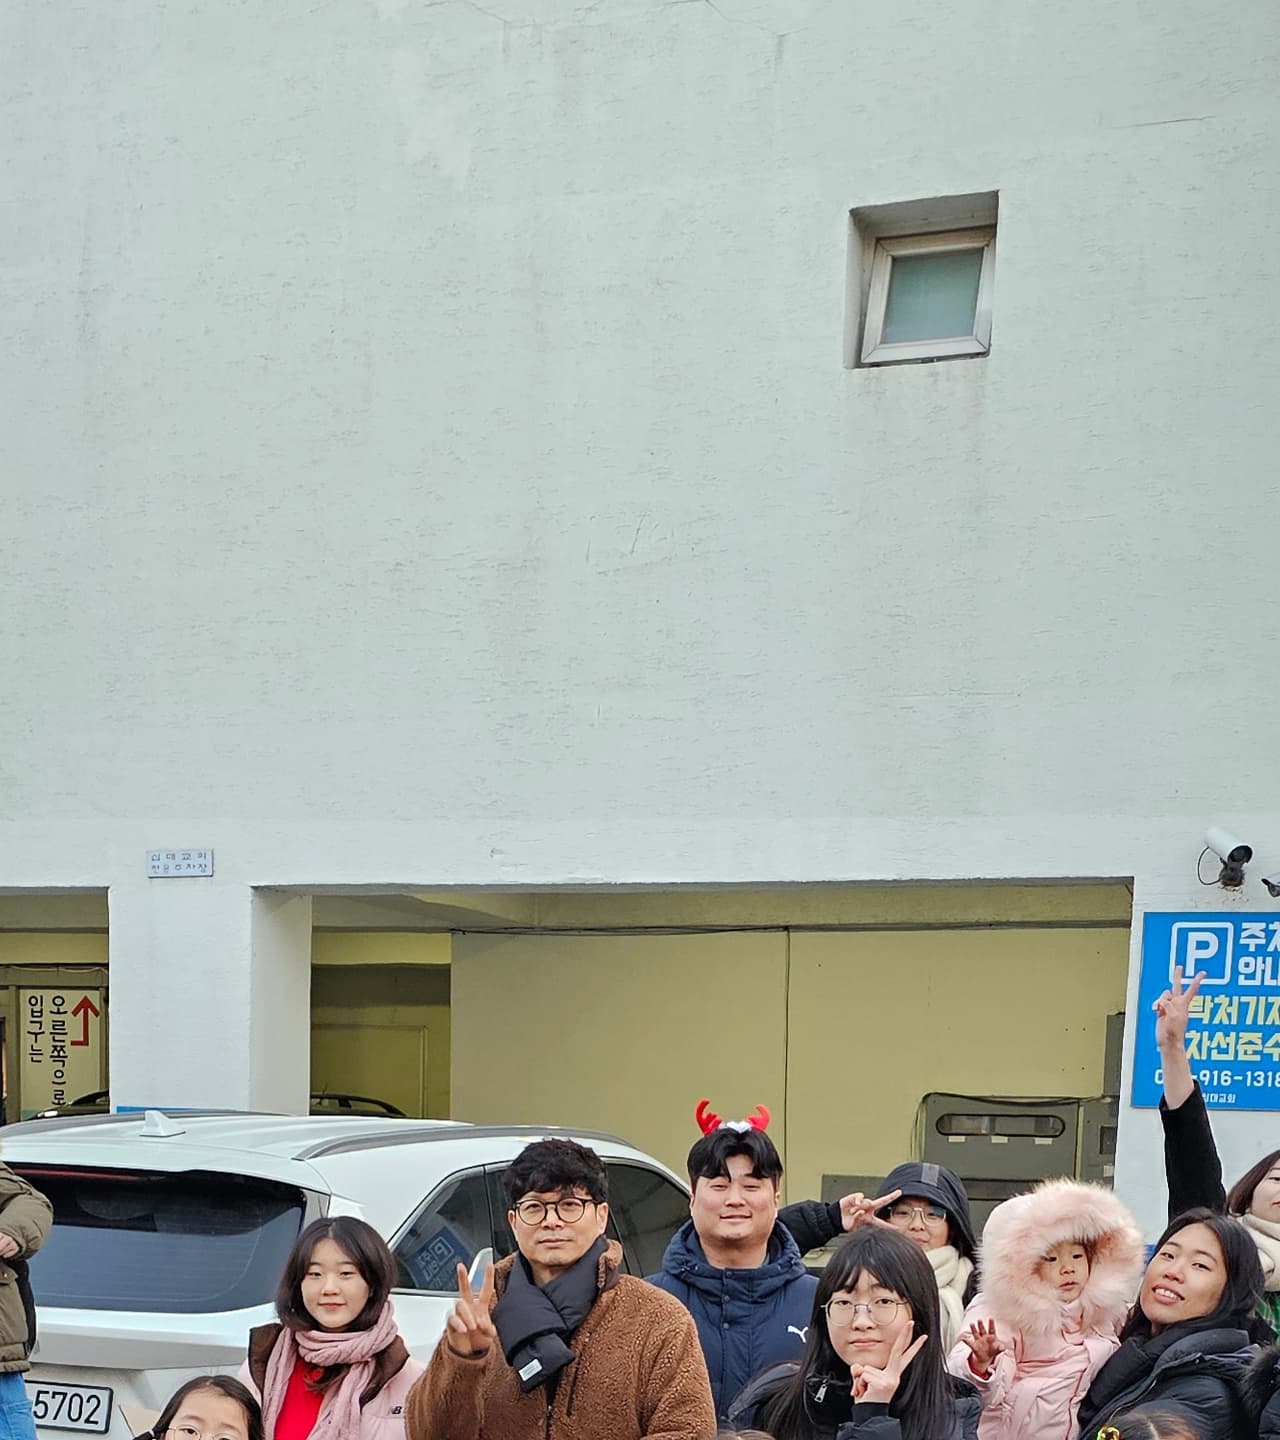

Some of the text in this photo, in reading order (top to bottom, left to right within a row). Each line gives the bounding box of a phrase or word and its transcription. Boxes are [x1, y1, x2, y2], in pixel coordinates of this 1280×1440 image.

[1186, 930, 1219, 978] P
[27, 995, 46, 1064] 입구는
[48, 995, 69, 1107] 오른쪽으로
[33, 1390, 102, 1426] 5702
